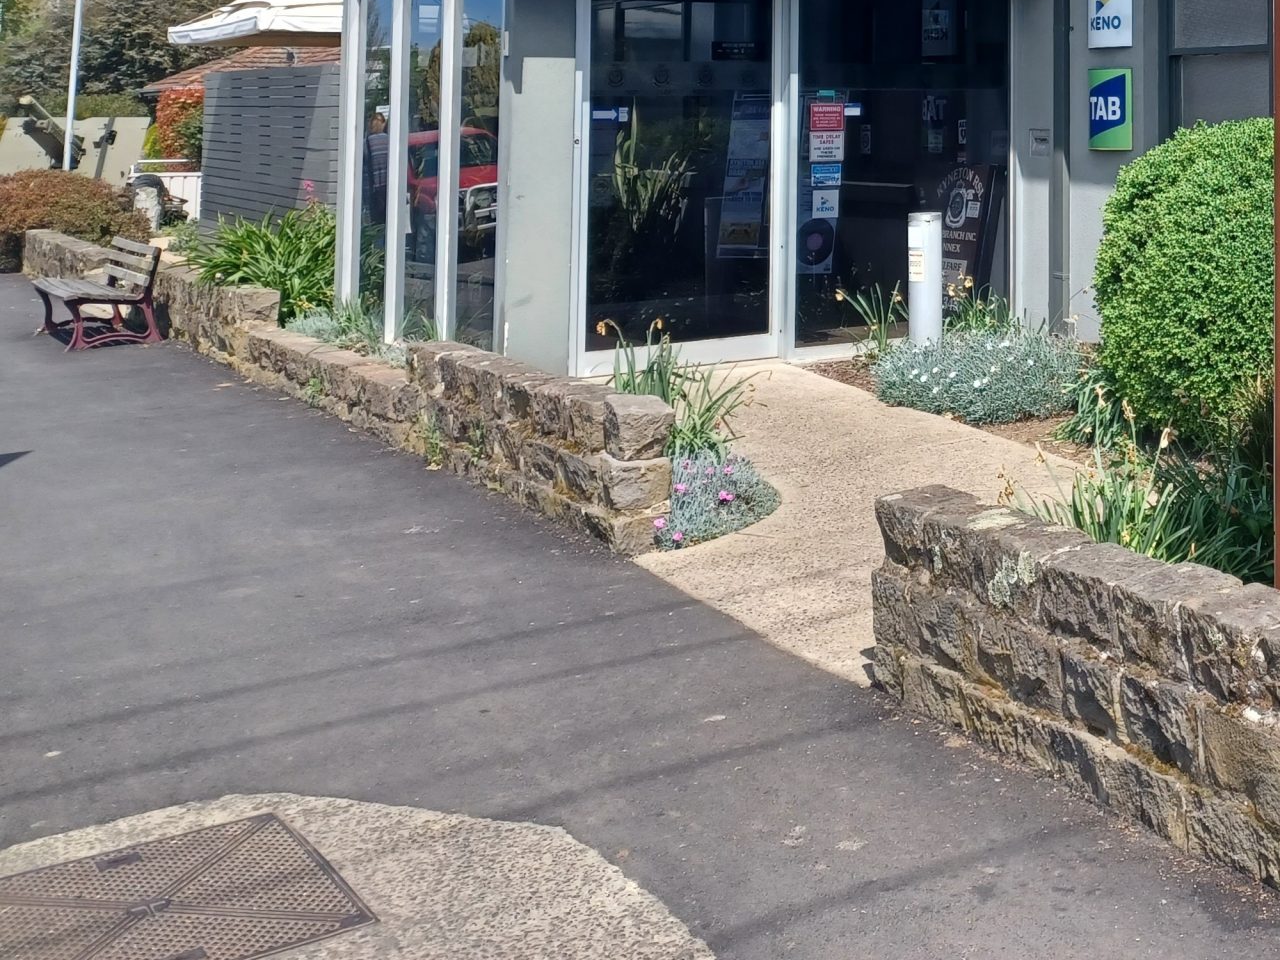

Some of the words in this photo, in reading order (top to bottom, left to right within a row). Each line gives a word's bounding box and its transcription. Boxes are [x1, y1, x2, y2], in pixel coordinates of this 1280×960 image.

[1090, 15, 1122, 31] KENO
[1090, 96, 1121, 121] TAB
[936, 167, 974, 198] KYNETON
[942, 242, 961, 253] NNEX
